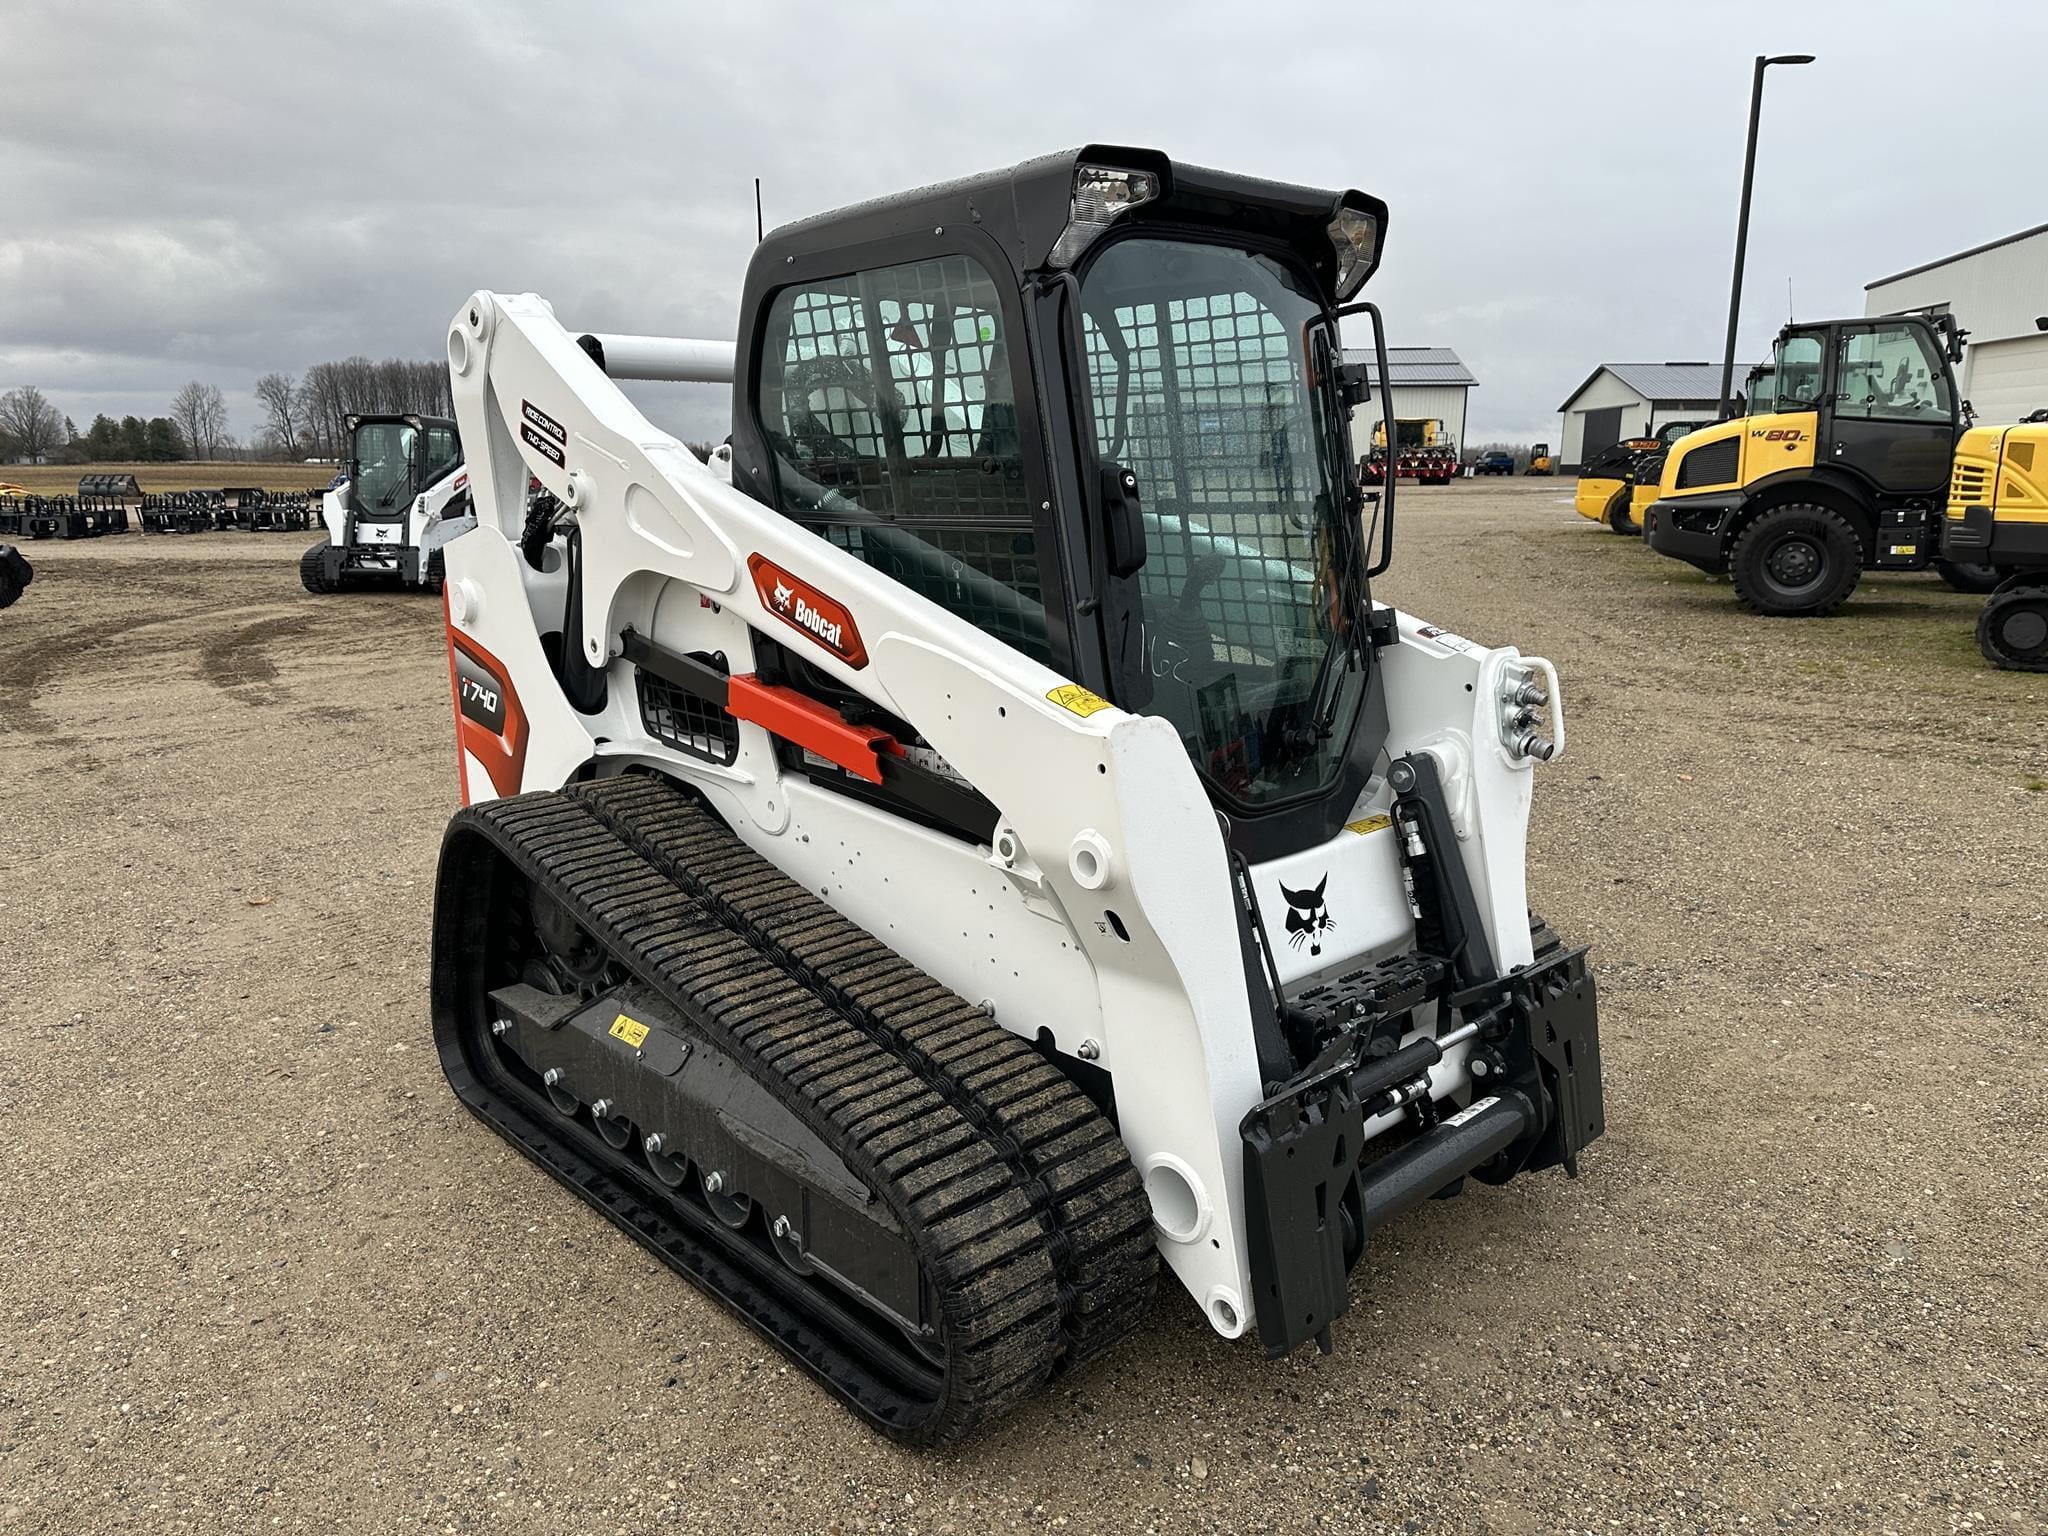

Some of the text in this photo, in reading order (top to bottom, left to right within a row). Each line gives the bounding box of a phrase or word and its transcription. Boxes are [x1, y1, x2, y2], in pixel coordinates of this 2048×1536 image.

[525, 406, 564, 440] RIDE CONTROL
[527, 431, 560, 460] TWO-SPEED
[795, 597, 842, 648] Bobcat
[462, 677, 498, 713] T740
